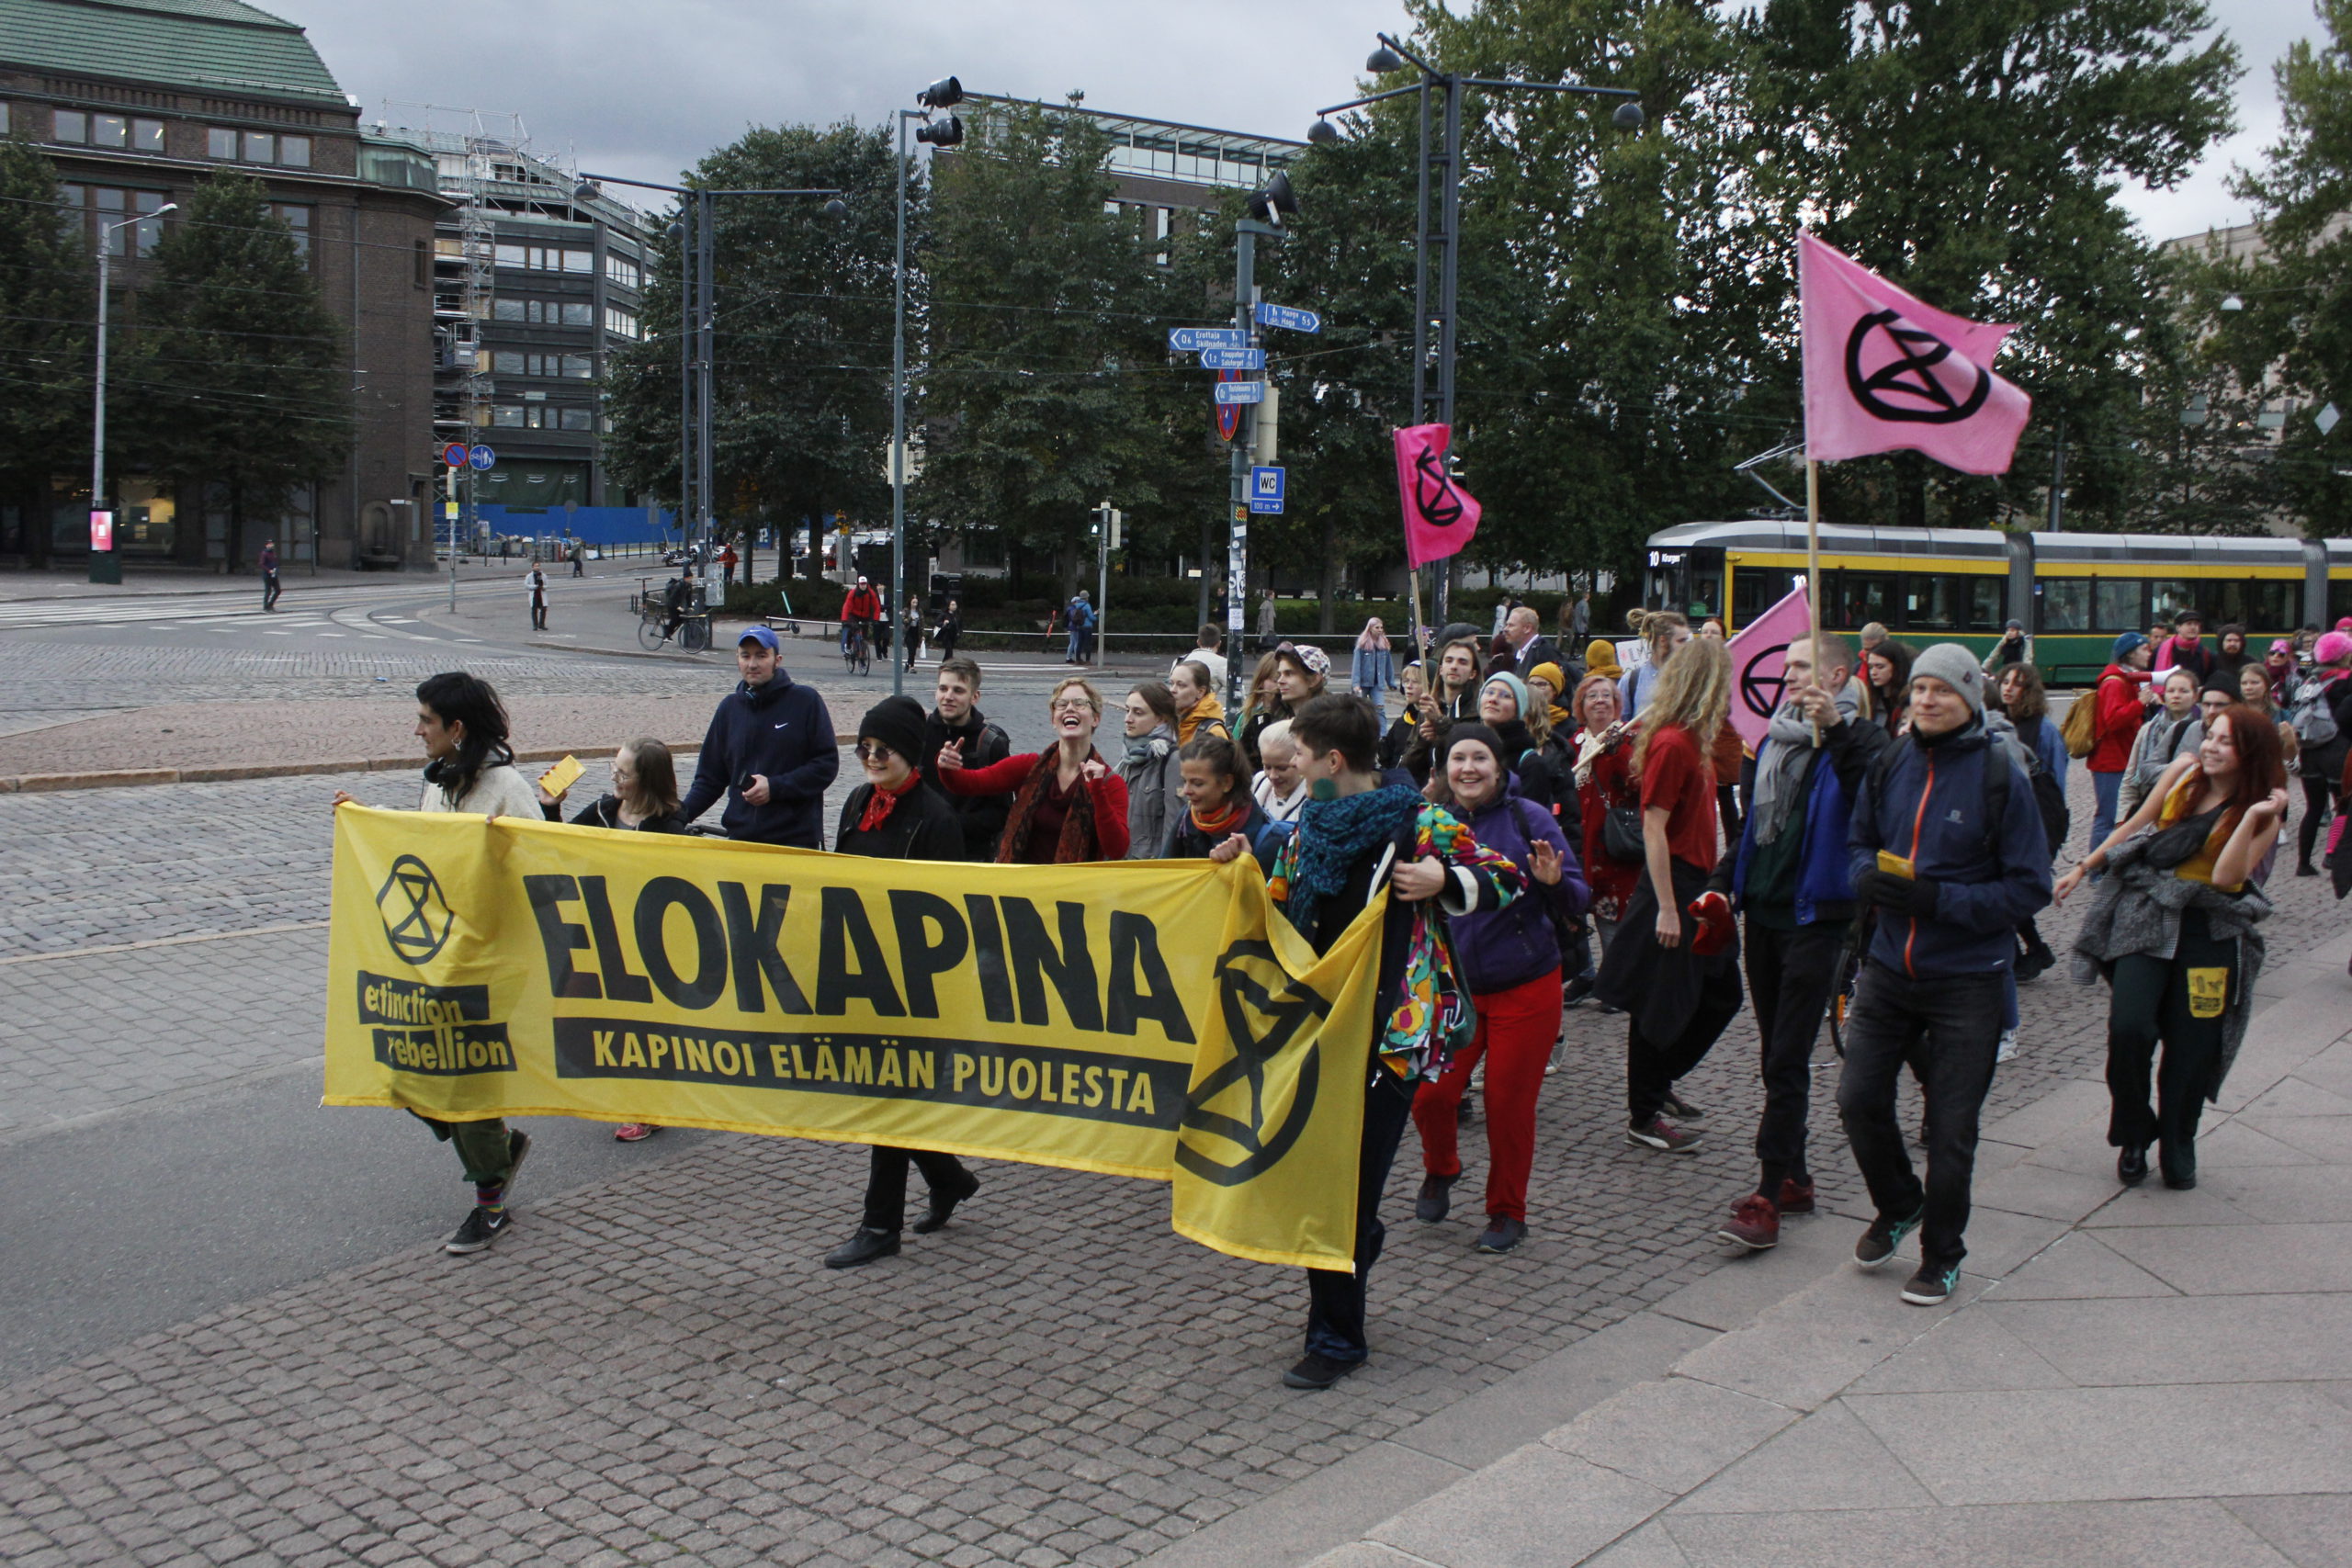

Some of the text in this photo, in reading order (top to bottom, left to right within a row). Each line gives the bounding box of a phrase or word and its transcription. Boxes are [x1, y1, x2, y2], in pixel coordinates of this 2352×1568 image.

[1282, 317, 1295, 327] Haga
[1195, 331, 1220, 339] Erottaja
[1261, 478, 1275, 490] WC
[1649, 550, 1659, 567] 10
[523, 874, 1197, 1044] ELOKAPINA
[388, 1029, 509, 1070] rebellion
[594, 1031, 1156, 1115] KAPINOI ELÄMÄN PUOLESTA
